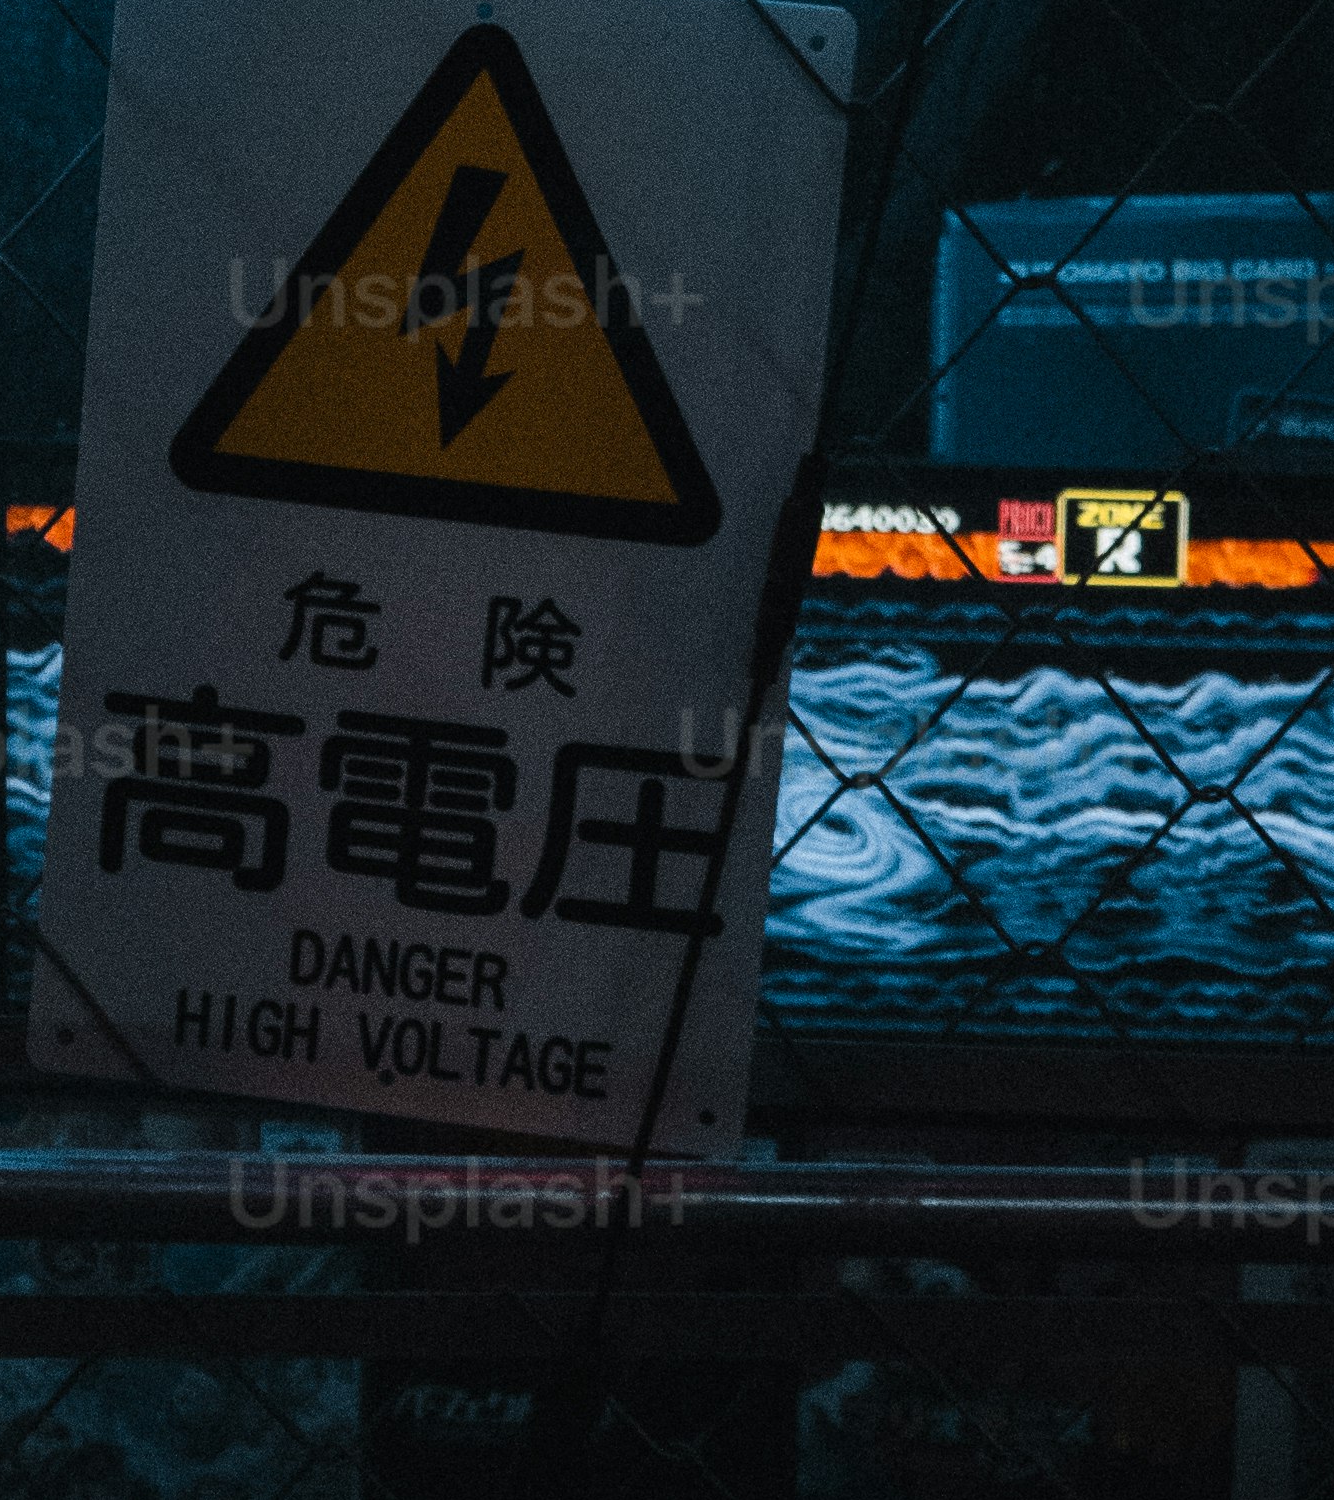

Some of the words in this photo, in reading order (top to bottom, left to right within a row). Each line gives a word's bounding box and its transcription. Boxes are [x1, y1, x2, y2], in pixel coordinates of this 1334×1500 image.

[278, 569, 583, 698] 危険
[98, 683, 727, 939] 高電圧
[288, 927, 510, 1012] DANGER
[174, 987, 320, 1066] HIGH
[358, 1009, 612, 1103] VOLTAGE
